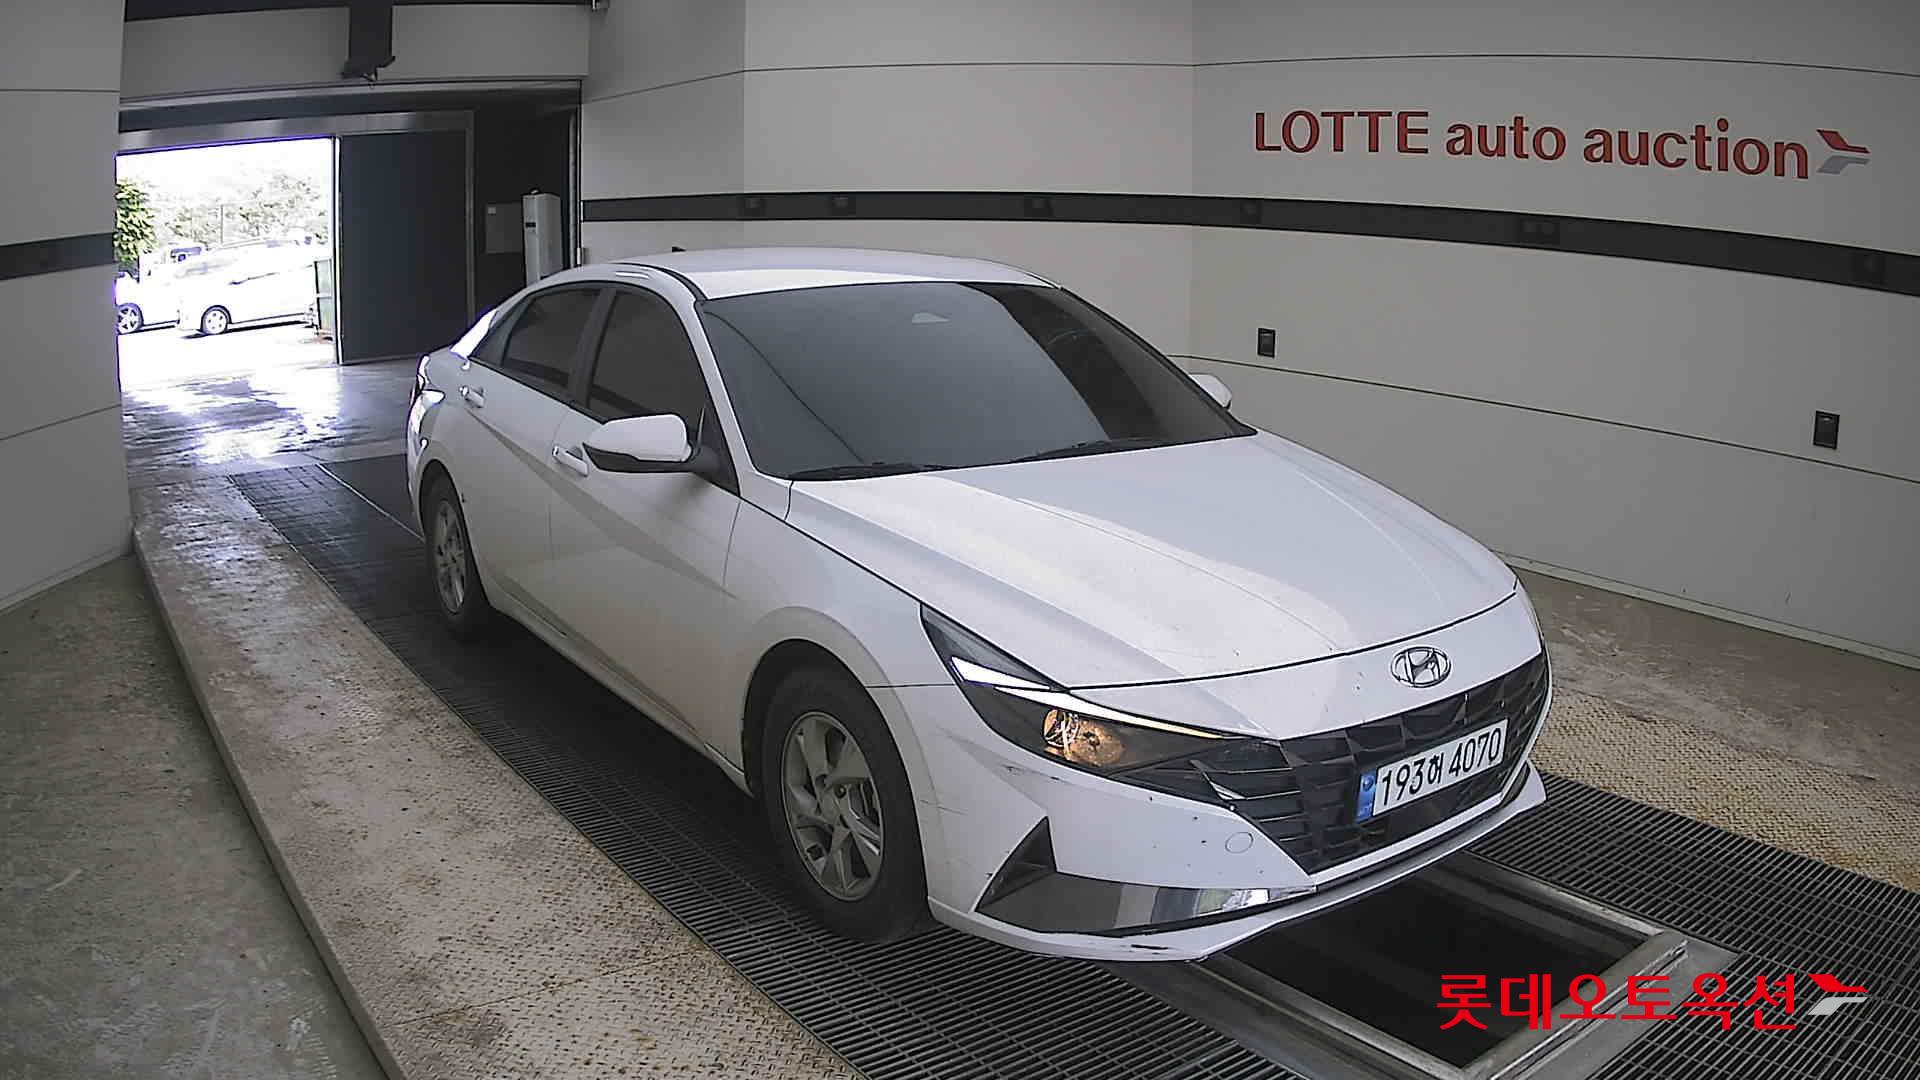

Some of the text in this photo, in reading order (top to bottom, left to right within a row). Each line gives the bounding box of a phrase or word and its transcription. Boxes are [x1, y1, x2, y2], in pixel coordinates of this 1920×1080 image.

[1255, 111, 1809, 179] LOTTE auto auction
[1448, 727, 1502, 777] 4070
